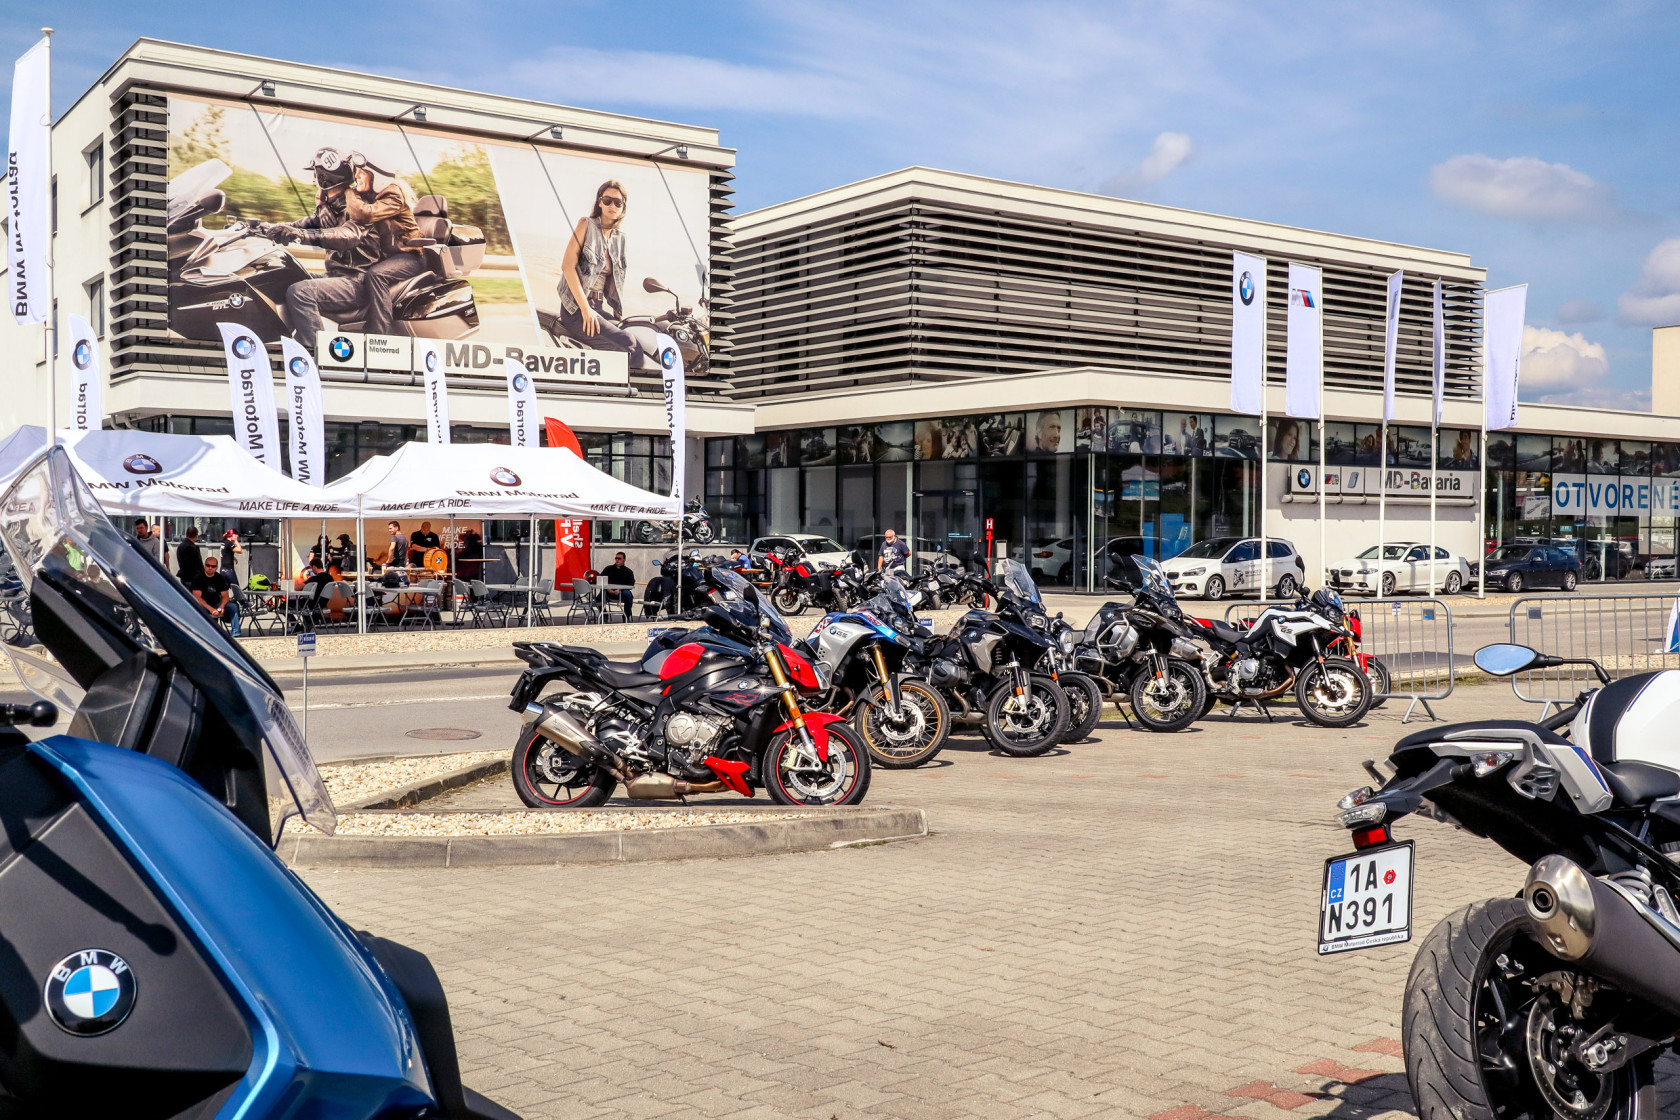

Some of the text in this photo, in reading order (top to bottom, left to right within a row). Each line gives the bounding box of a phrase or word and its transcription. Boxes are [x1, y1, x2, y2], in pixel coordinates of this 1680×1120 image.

[369, 338, 388, 346] BMW
[369, 346, 400, 354] Motorrad
[86, 477, 230, 494] MW Motorrad
[1380, 470, 1461, 491] MD-Baaria
[504, 490, 580, 499] Motorrad
[1555, 481, 1680, 509] OTVORENÉ
[239, 501, 340, 512] MAKE LIFE A RIDE.
[380, 498, 472, 511] MAKE LIFE A RIDE.
[591, 504, 616, 512] MAKE
[618, 504, 637, 513] LIFE
[646, 506, 668, 515] RIDE.
[986, 519, 993, 529] H
[1350, 860, 1378, 893] 1A
[1330, 888, 1343, 899] CZ
[1328, 892, 1394, 934] N391
[1331, 942, 1344, 950] BMW
[53, 951, 128, 983] BMW
